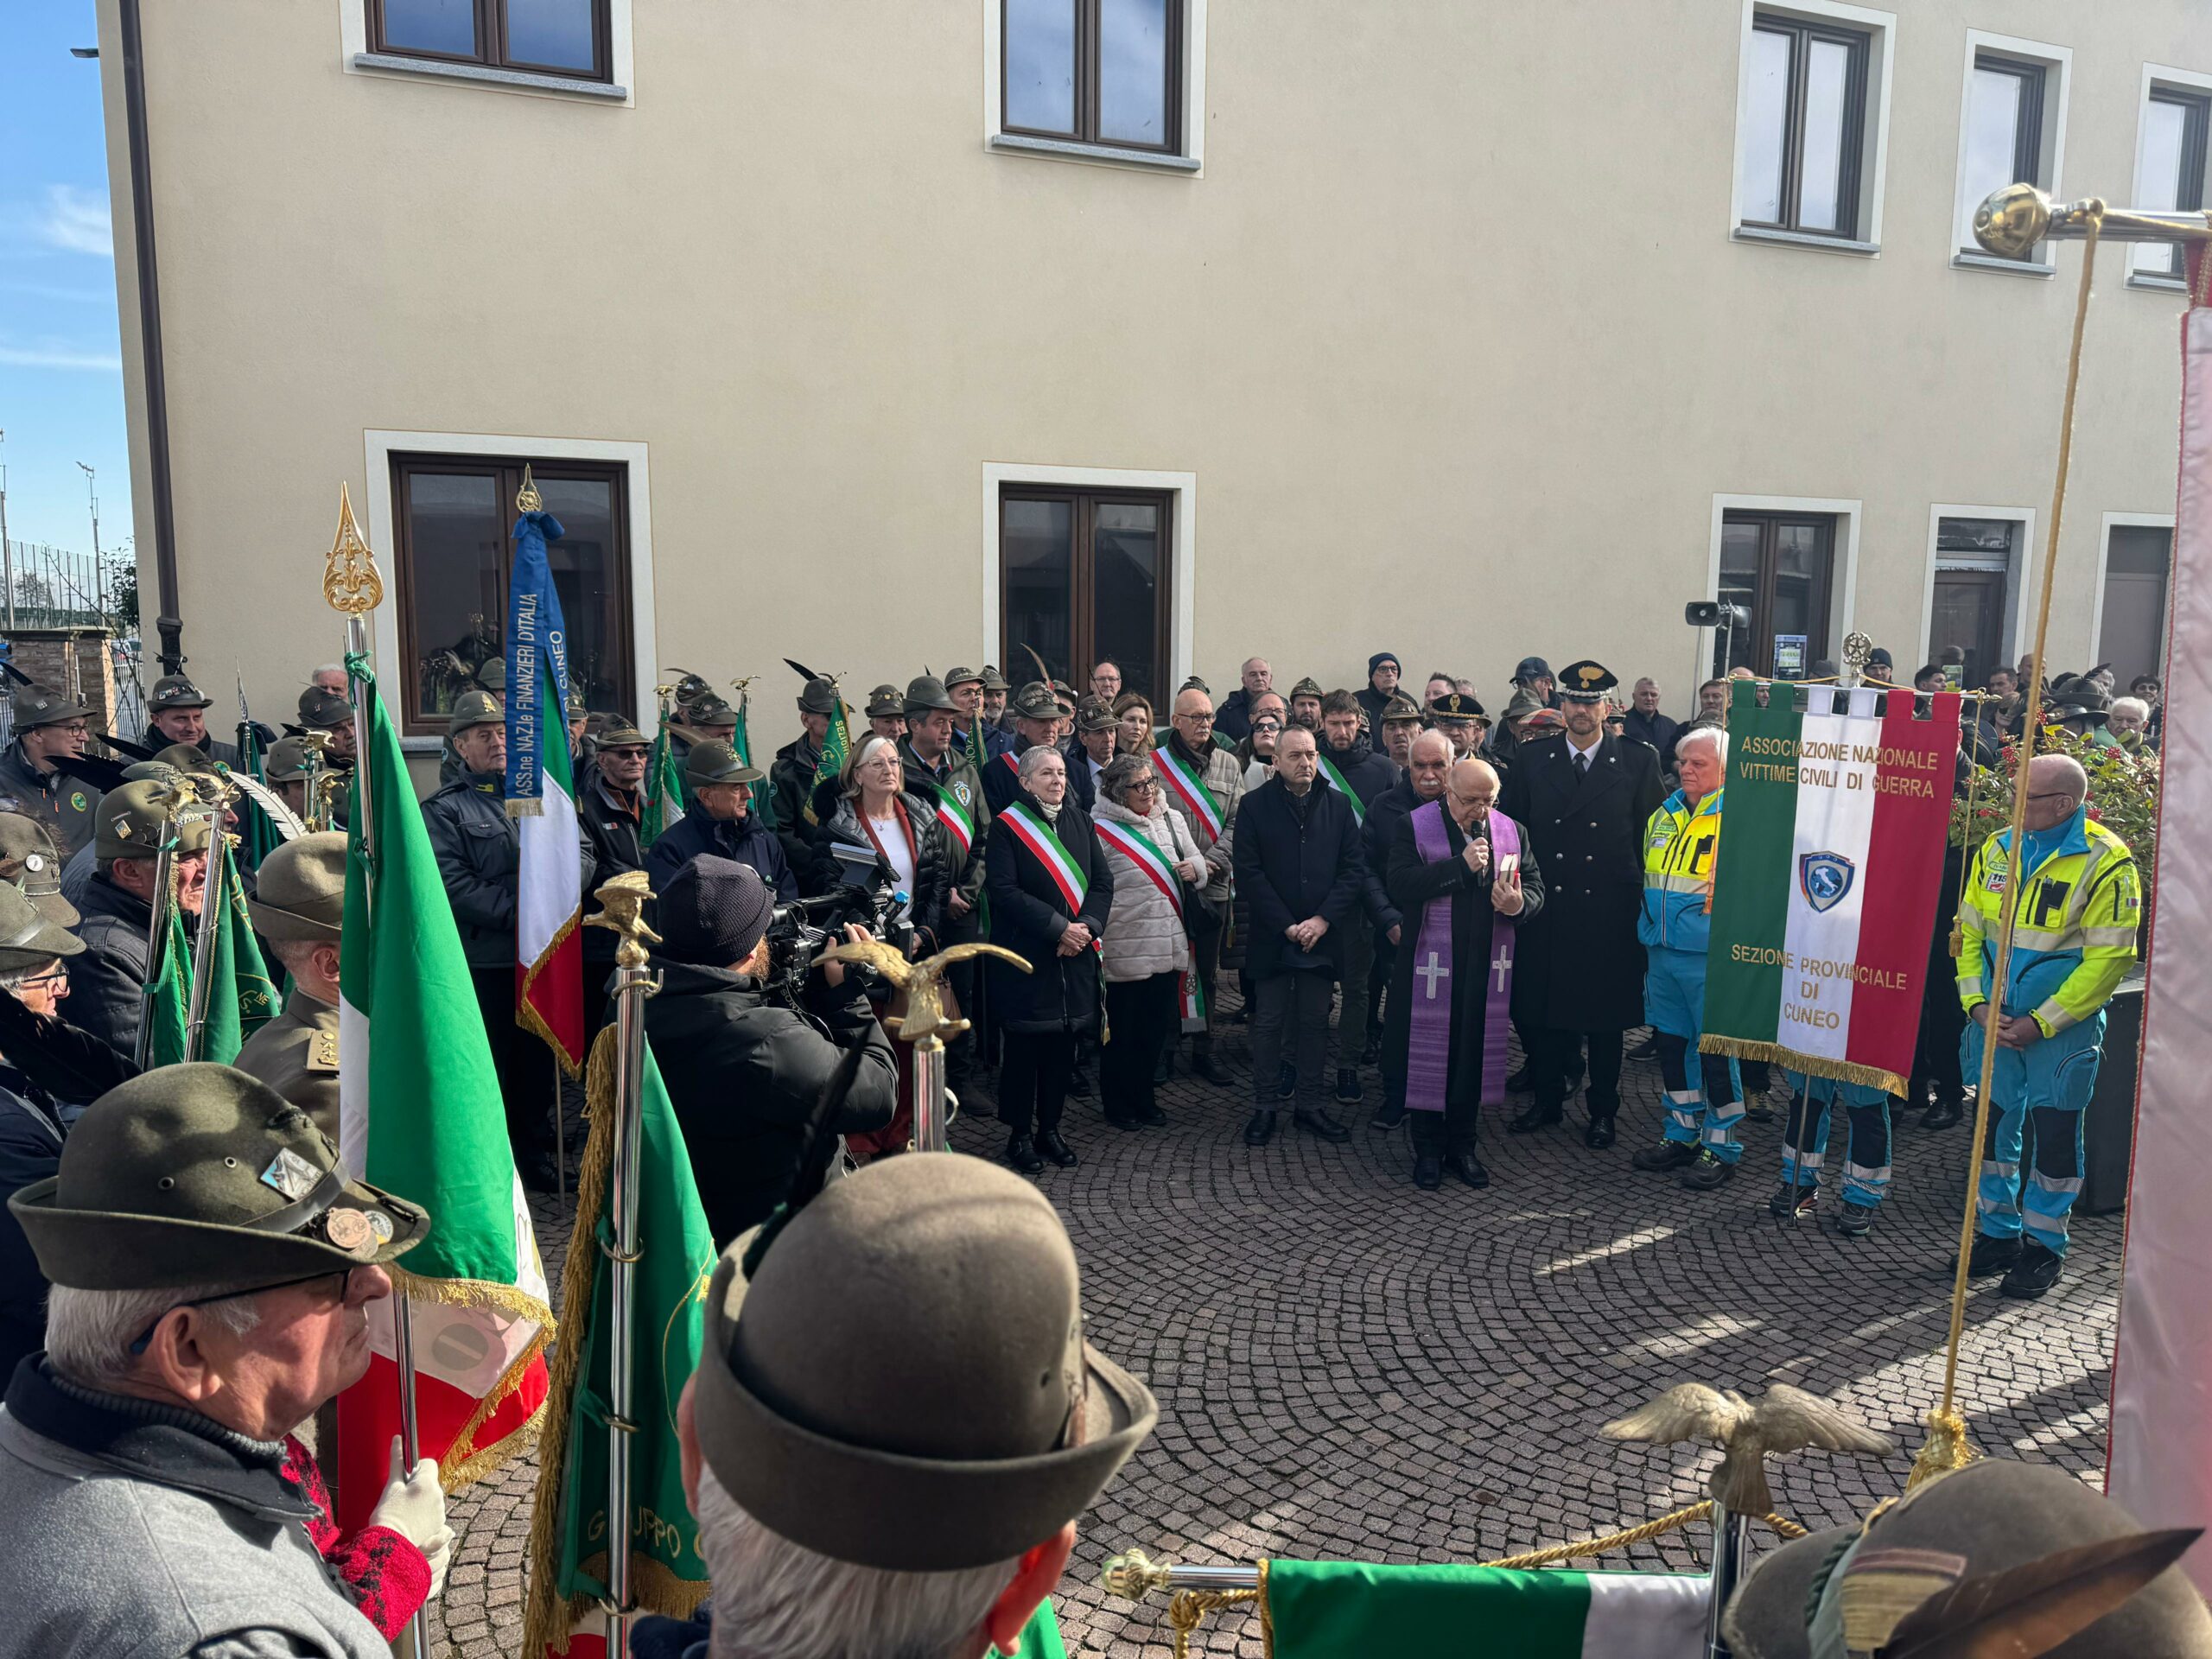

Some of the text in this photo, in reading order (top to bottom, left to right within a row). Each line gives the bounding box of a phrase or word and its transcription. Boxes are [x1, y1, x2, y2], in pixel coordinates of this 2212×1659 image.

[517, 594, 537, 642] D'ITALIA
[516, 644, 536, 711] FINANZIERI
[549, 630, 569, 690] CUNEO
[1740, 735, 1939, 771] ASSOCIAZIONE NAZIONALE
[515, 755, 534, 797] ASS.ne
[1739, 761, 1935, 798] VITTIME CIVILI DI GUERRA
[1731, 944, 1908, 991] SEZIONE PROVINCIALE
[1800, 980, 1820, 1000] DI
[1783, 1001, 1840, 1030] CUNEO
[588, 1505, 682, 1559] GUPPO
